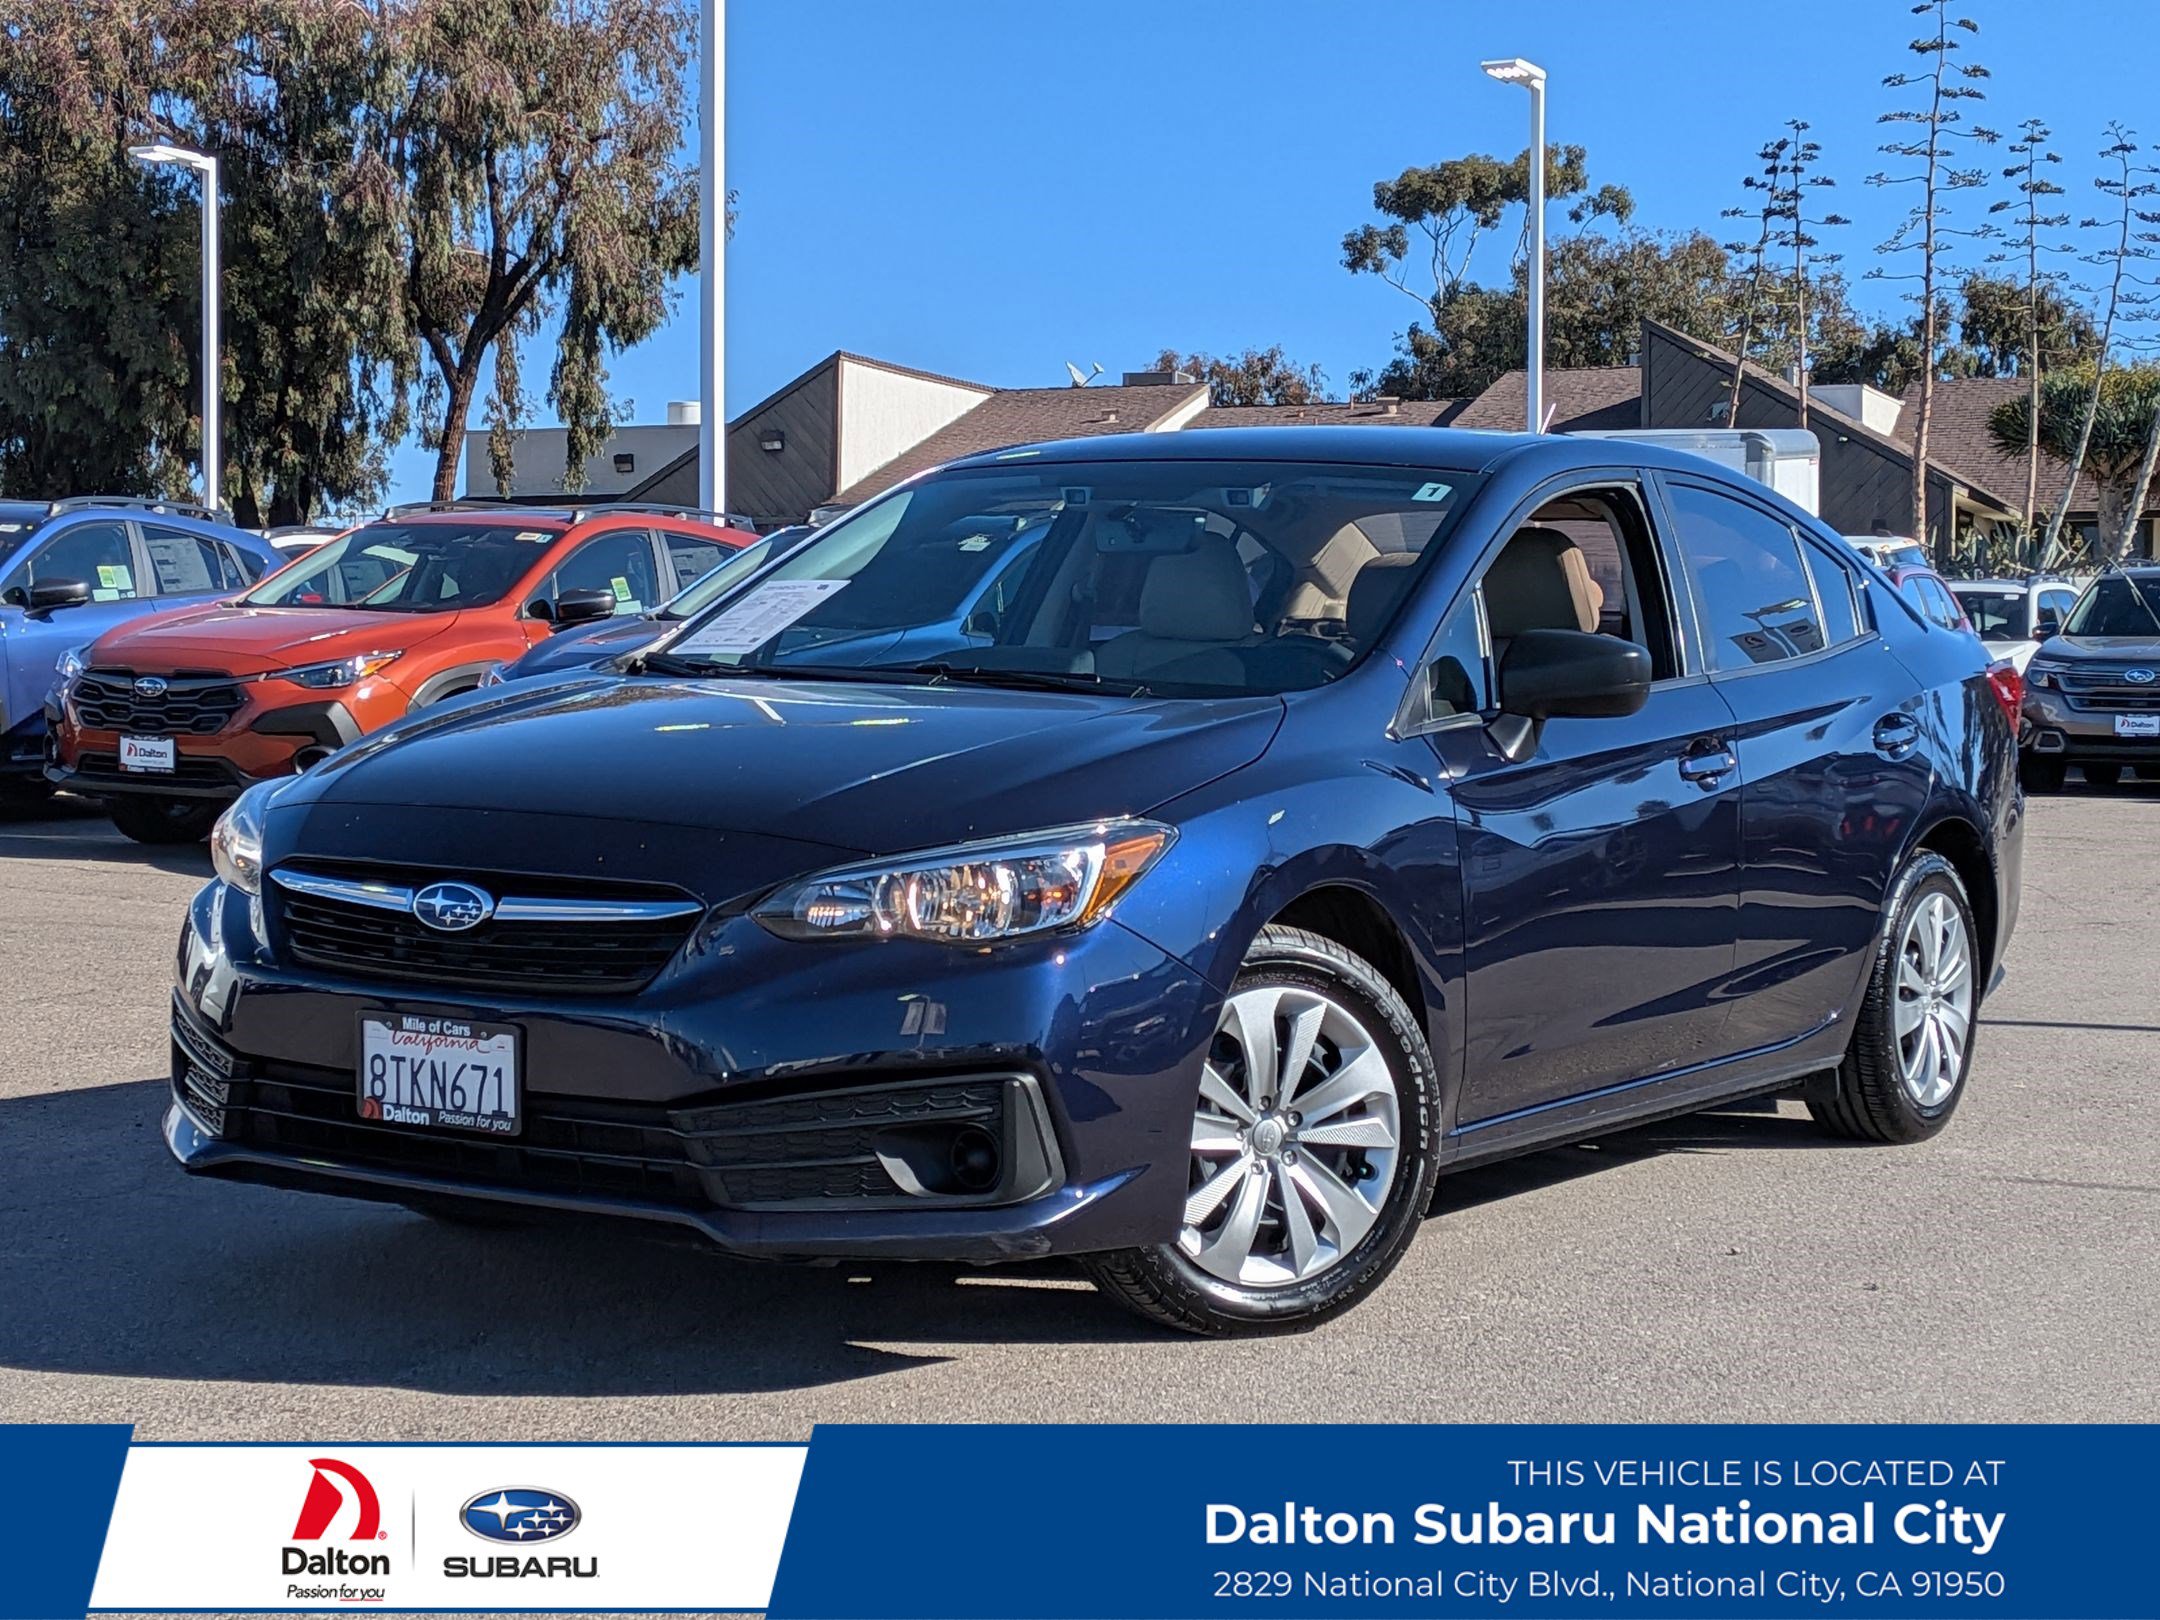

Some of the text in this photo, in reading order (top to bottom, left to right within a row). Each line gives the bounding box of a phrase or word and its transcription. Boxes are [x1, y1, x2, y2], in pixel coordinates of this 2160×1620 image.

[139, 747, 168, 758] Dalton
[402, 1016, 471, 1037] Mile of Cars
[392, 1029, 490, 1056] California
[370, 1053, 508, 1118] 8TKN671
[382, 1103, 512, 1132] Dalton Passion for you
